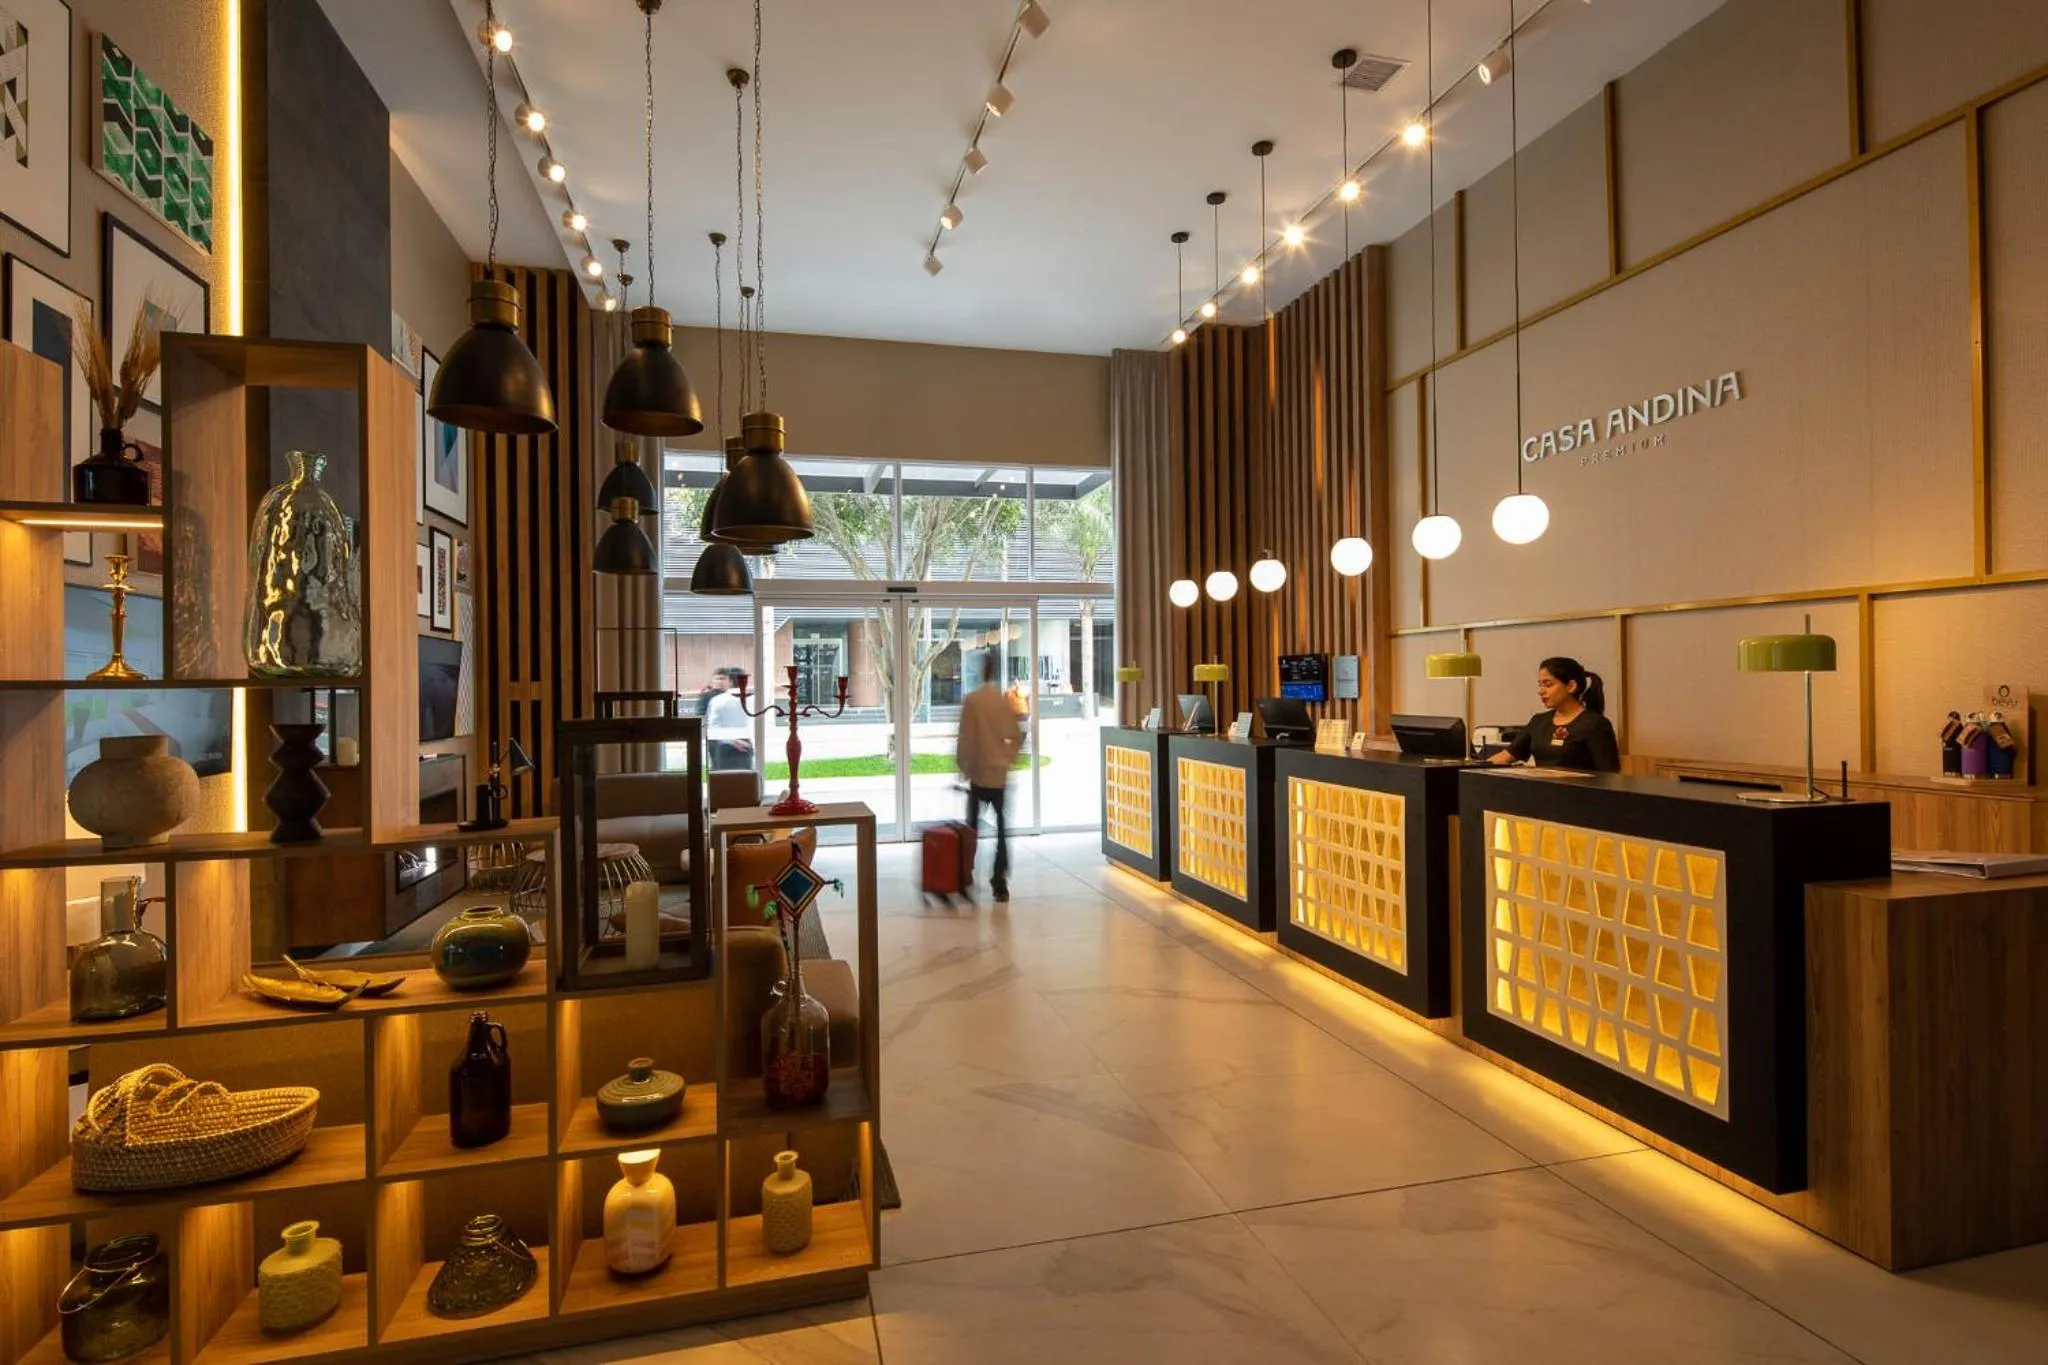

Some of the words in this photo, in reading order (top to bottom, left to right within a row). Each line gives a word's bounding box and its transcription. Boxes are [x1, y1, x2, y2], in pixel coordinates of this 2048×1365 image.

[1522, 418, 1596, 462] CASA
[1606, 371, 1741, 439] ANDINA
[1579, 434, 1666, 466] PREMIUM
